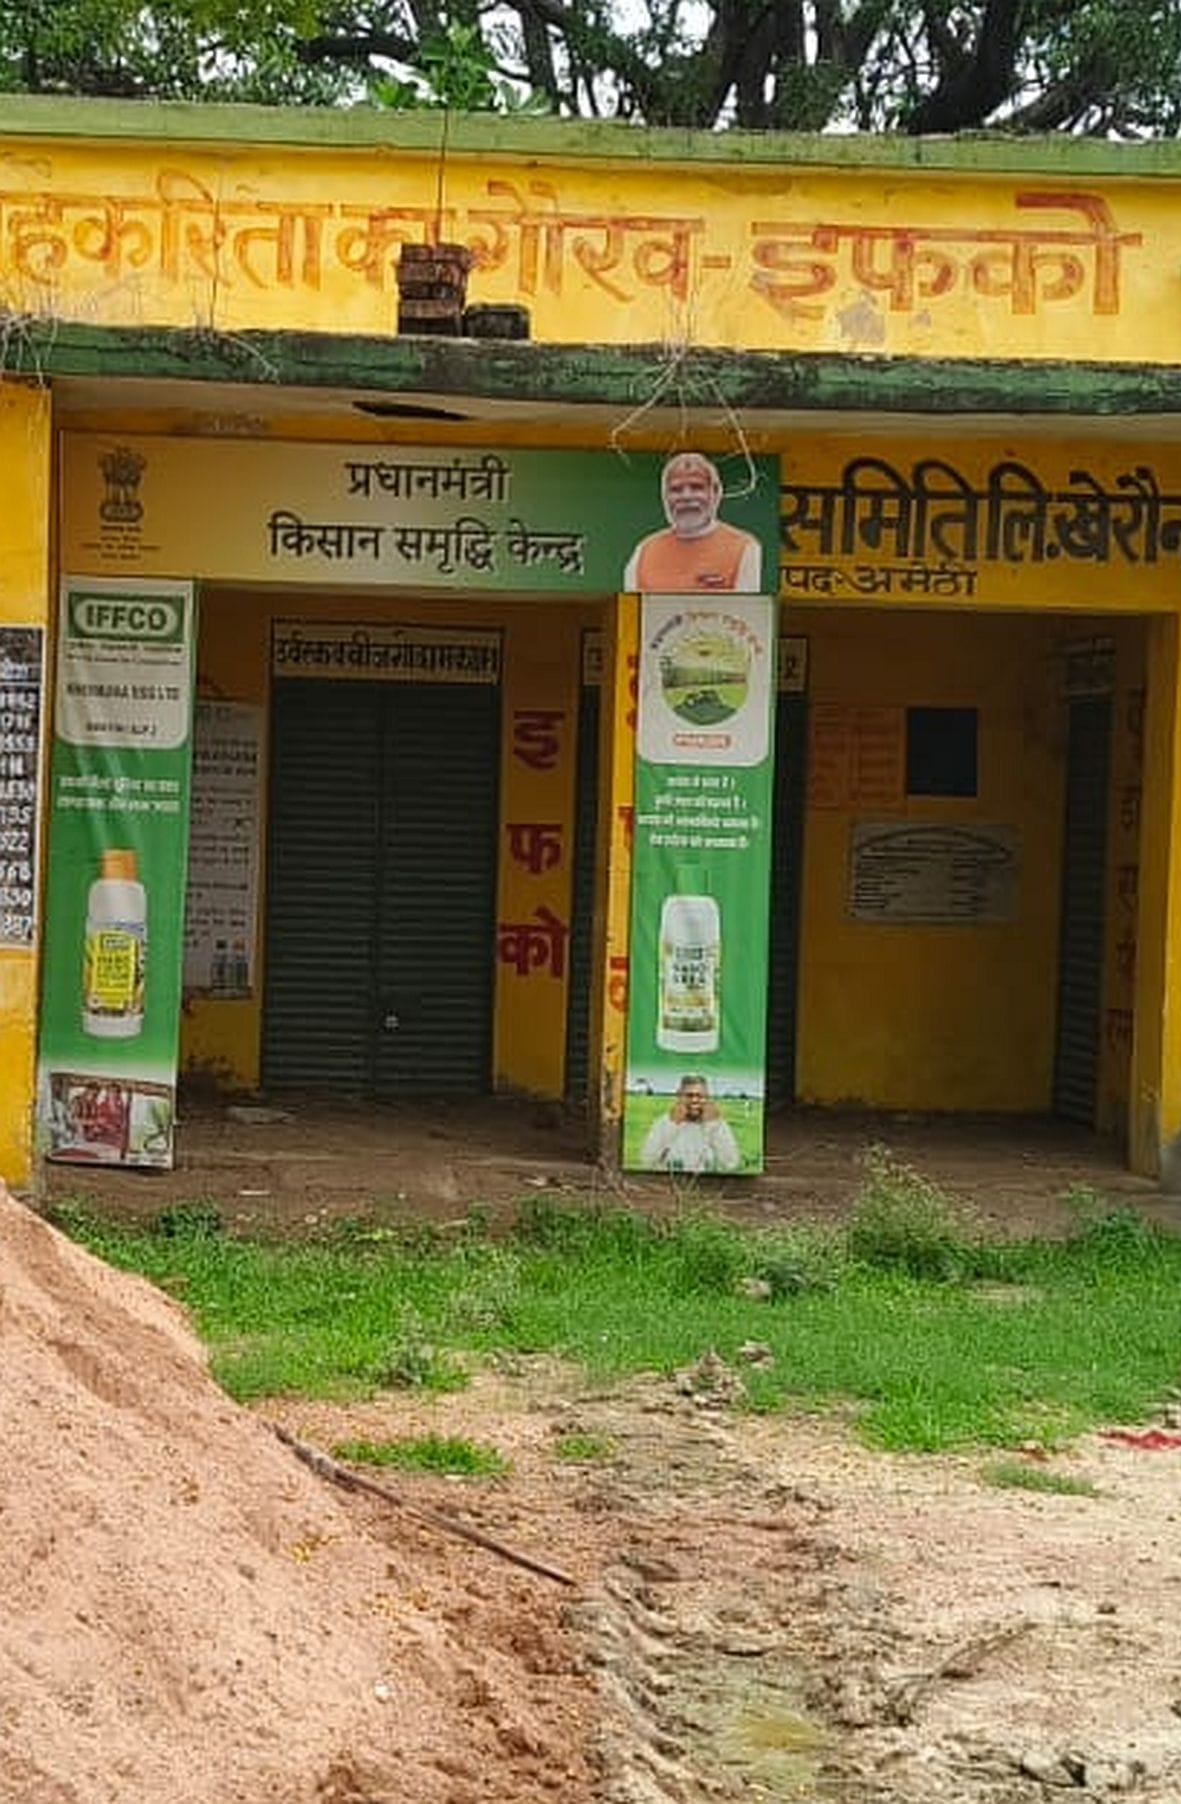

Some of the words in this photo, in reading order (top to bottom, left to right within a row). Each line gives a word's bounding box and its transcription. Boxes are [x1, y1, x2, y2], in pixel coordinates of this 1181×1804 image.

[752, 191, 1143, 320] इफको
[344, 455, 511, 501] प्रधानमंत्री
[268, 511, 384, 561] किसान
[394, 515, 497, 574] समृद्धि
[505, 518, 585, 575] केन्द्र
[86, 605, 167, 631] IFFCO
